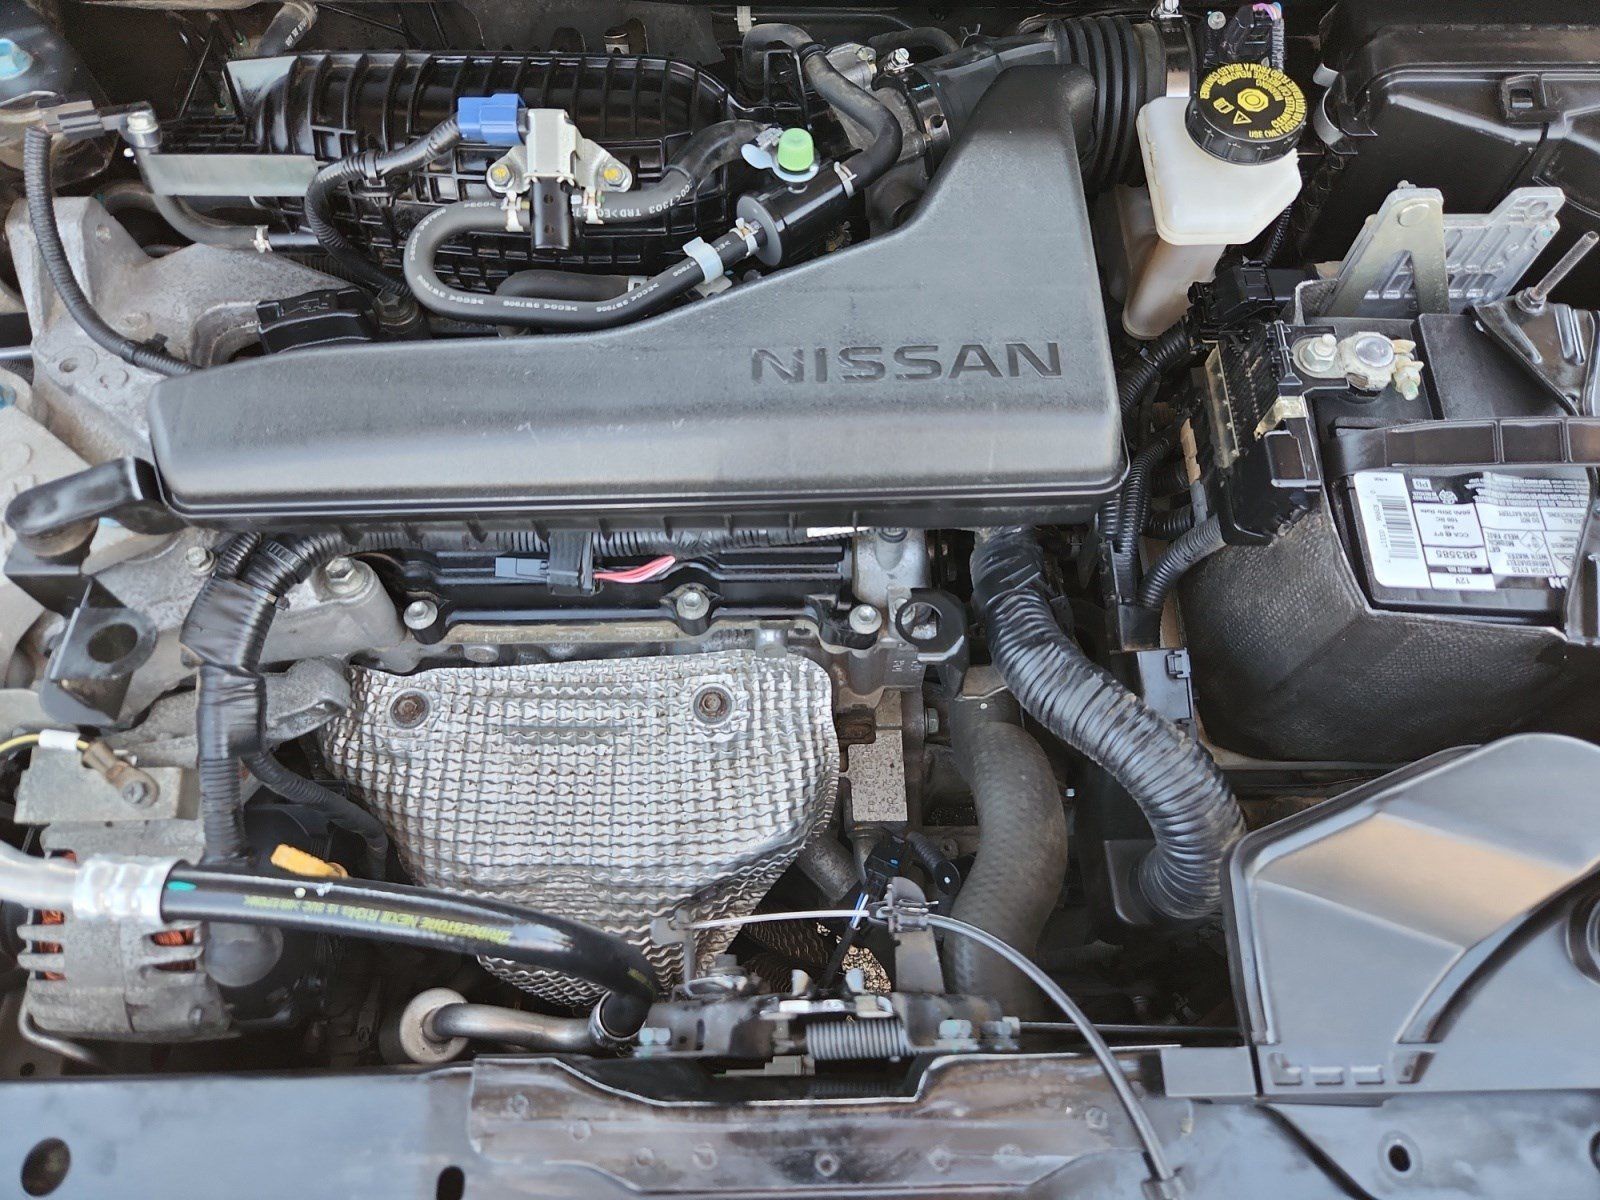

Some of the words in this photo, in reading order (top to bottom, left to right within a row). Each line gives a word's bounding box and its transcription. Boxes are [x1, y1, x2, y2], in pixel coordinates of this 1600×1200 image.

[1217, 63, 1243, 76] SEALED
[1249, 63, 1272, 74] FROM
[1269, 68, 1291, 83] FLUID
[1216, 70, 1251, 86] REMOVING
[1253, 71, 1283, 87] BEFORE
[1269, 111, 1292, 128] CLEAN
[1248, 130, 1263, 138] USE
[1263, 126, 1285, 138] ONLY
[752, 342, 1062, 383] NISSAN
[1436, 550, 1478, 559] 983585
